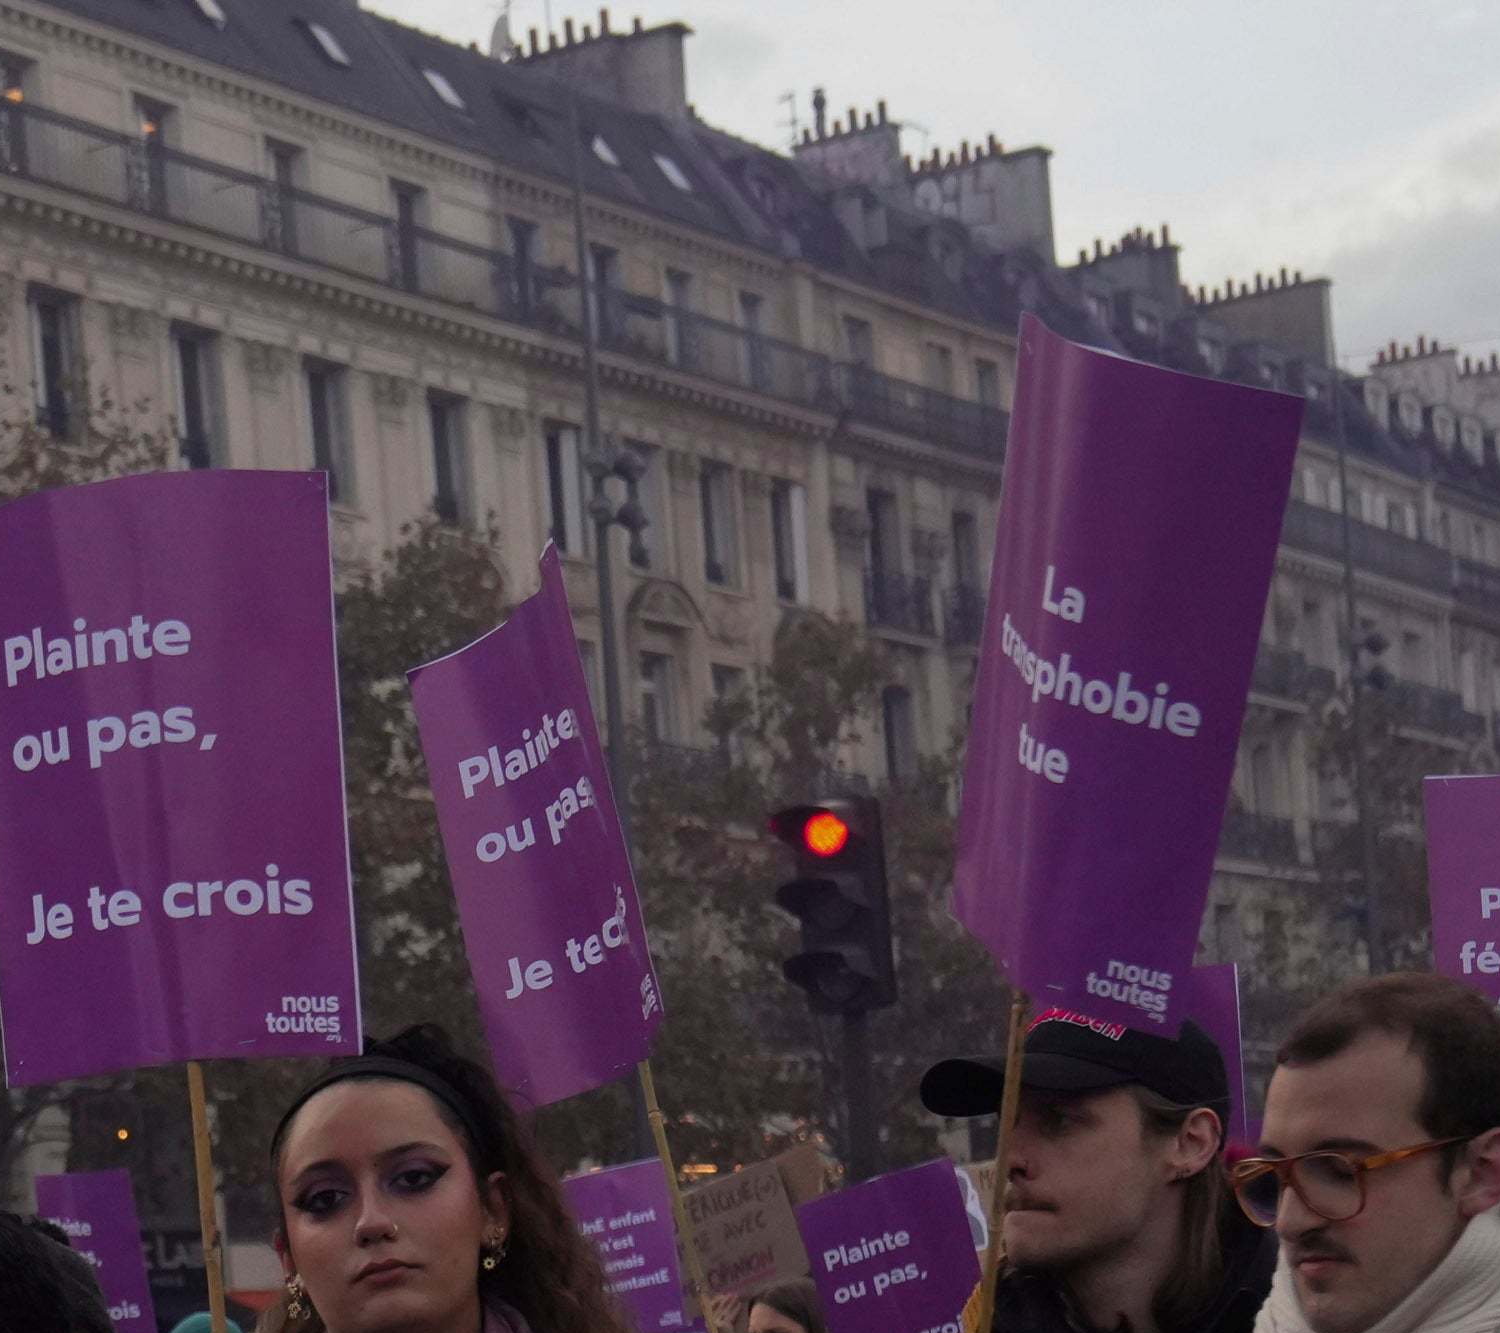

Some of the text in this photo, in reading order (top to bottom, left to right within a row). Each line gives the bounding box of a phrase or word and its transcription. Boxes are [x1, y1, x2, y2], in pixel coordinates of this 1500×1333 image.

[1041, 565, 1085, 623] La
[4, 615, 191, 687] Plainte
[1000, 612, 1201, 738] transphobie
[13, 705, 217, 771] ou pas,
[458, 708, 578, 799] Plainte
[1018, 723, 1070, 785] tue
[476, 818, 536, 863] ou
[27, 863, 314, 945] Je te crois
[505, 937, 606, 999] Je te
[1086, 971, 1168, 1011] toutes
[1107, 959, 1172, 991] nous
[265, 1012, 341, 1034] toutes
[282, 995, 340, 1012] nous
[609, 1208, 656, 1230] enfant
[824, 1230, 910, 1272] Plainte
[834, 1262, 928, 1304] ou pas,
